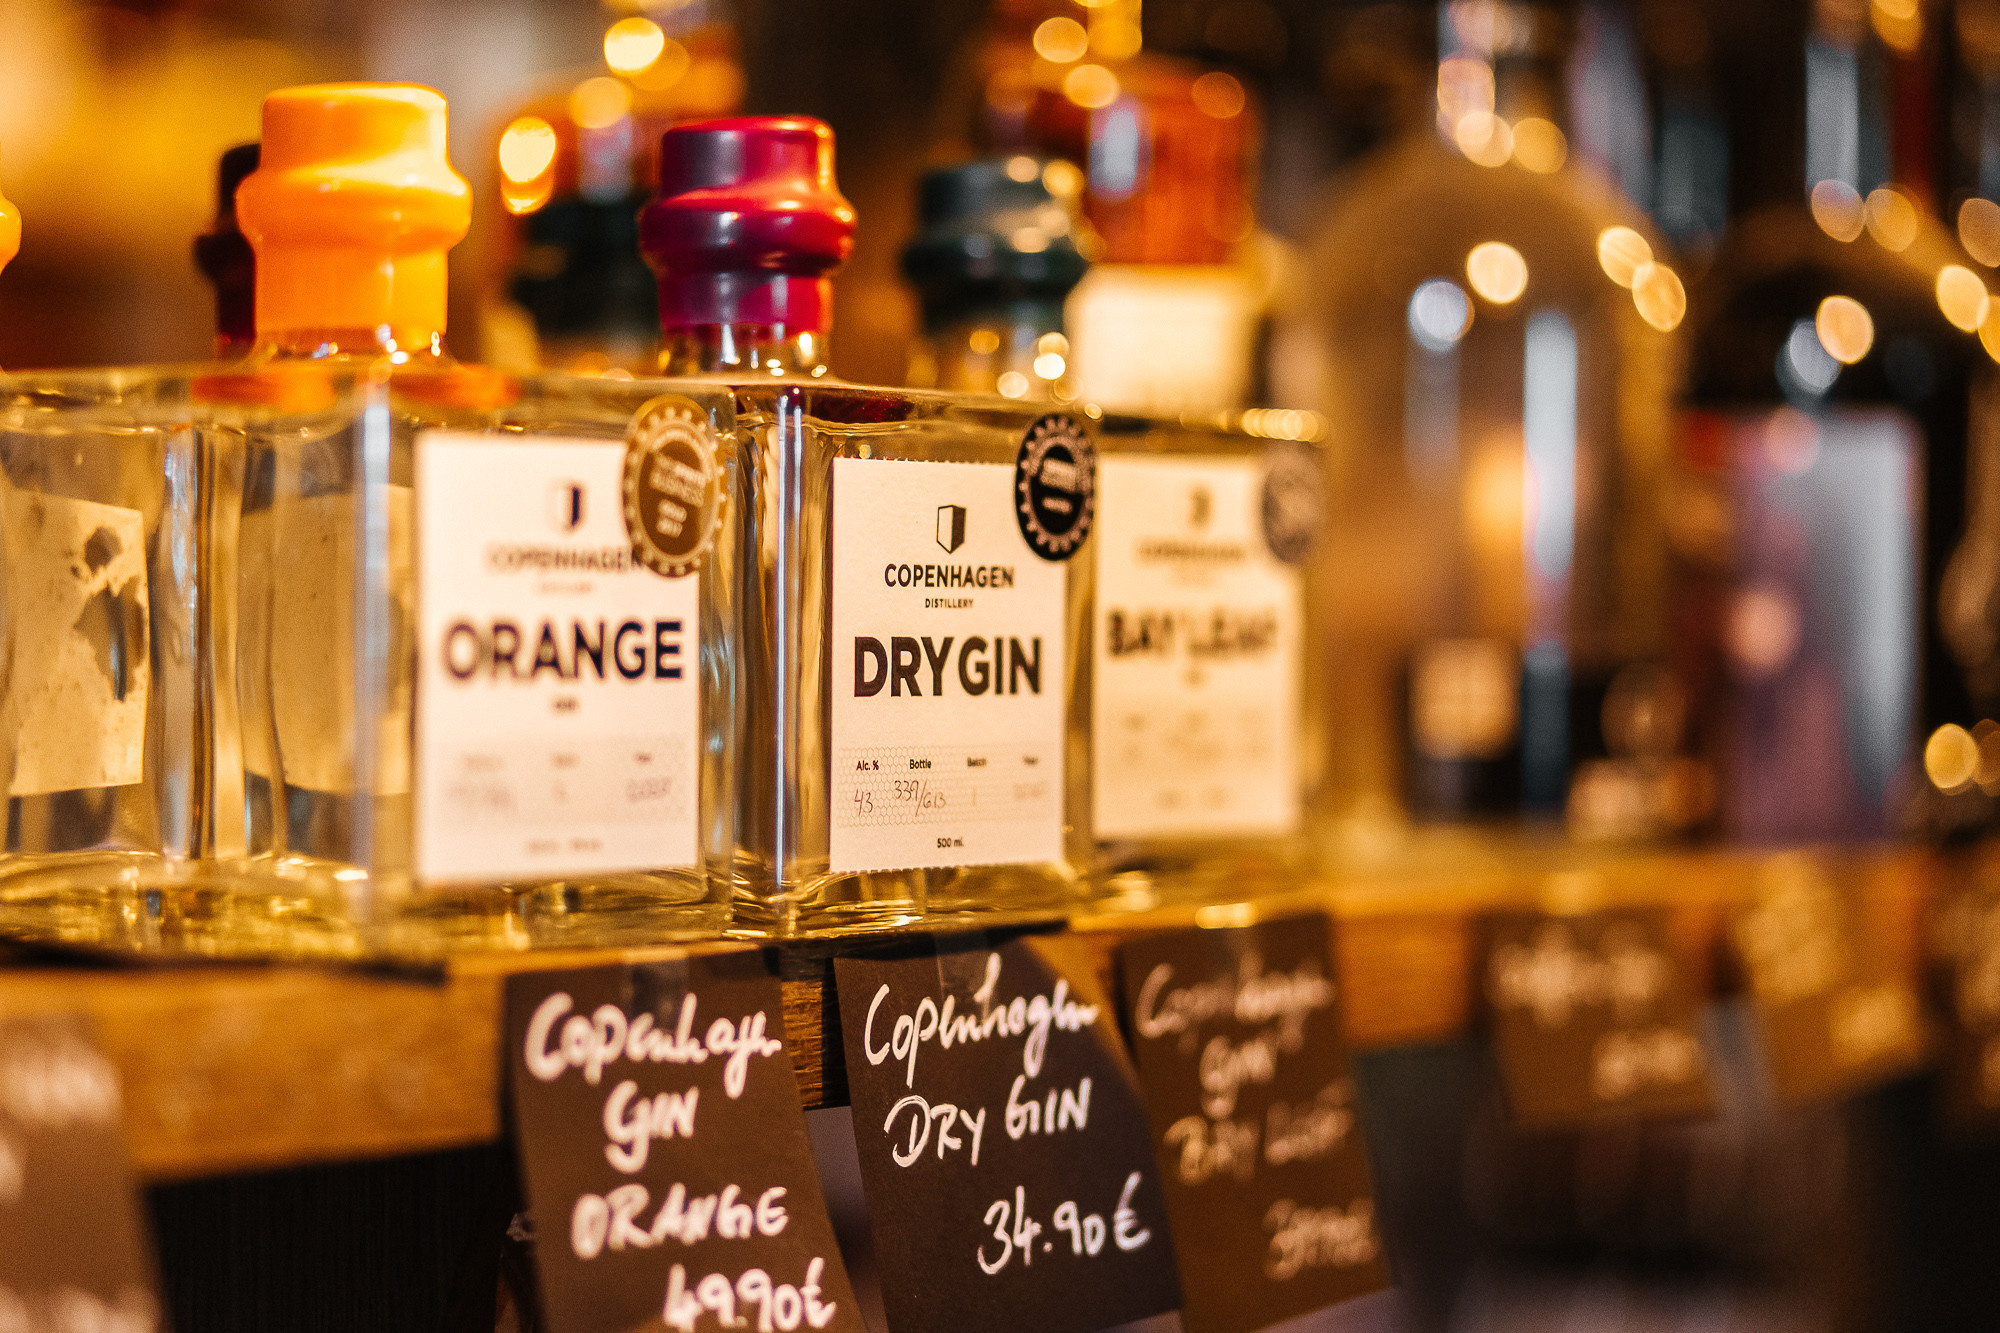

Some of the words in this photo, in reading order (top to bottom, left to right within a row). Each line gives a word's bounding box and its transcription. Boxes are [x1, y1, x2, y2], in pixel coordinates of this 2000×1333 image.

[884, 563, 1014, 588] COPENHAGEN
[925, 598, 974, 609] DISTILLERY
[445, 619, 682, 680] ORANGE
[854, 636, 954, 697] DRY
[958, 636, 1042, 696] GIN
[856, 759, 871, 771] Alc.
[872, 760, 880, 771] %
[909, 758, 932, 770] Bottle
[854, 788, 874, 817] 43
[937, 837, 951, 848] 500
[604, 1080, 699, 1173] GIN
[884, 1095, 985, 1167] DRY
[1005, 1074, 1091, 1140] GIN
[571, 1182, 789, 1259] ORANGE
[977, 1171, 1150, 1274] 34.90€
